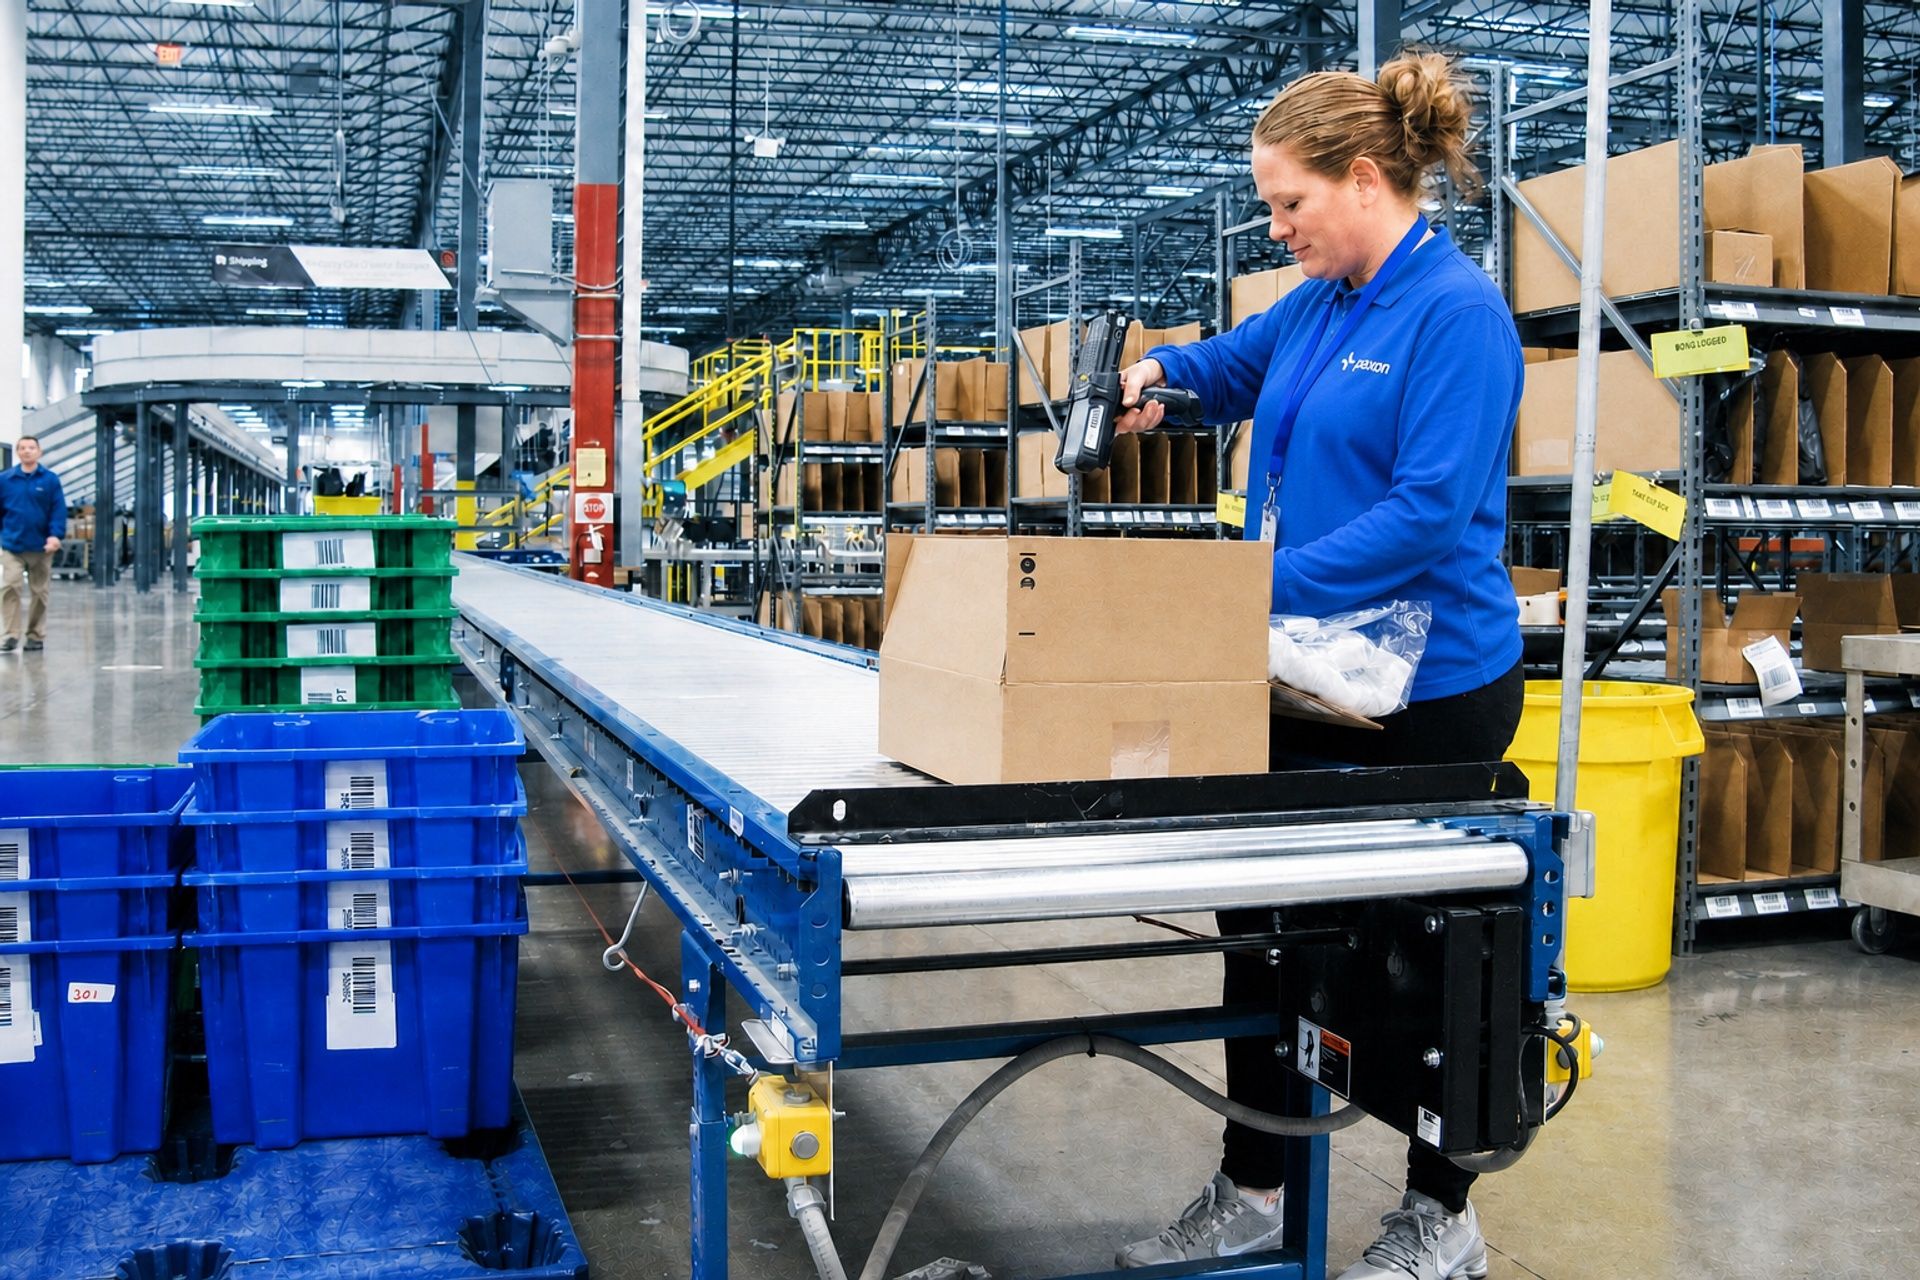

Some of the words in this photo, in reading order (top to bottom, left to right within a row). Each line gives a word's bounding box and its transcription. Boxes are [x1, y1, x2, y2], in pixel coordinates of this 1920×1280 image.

[228, 256, 268, 269] Shipping
[1352, 358, 1391, 374] paxon
[584, 503, 605, 513] STOP
[73, 988, 98, 1001] 301
